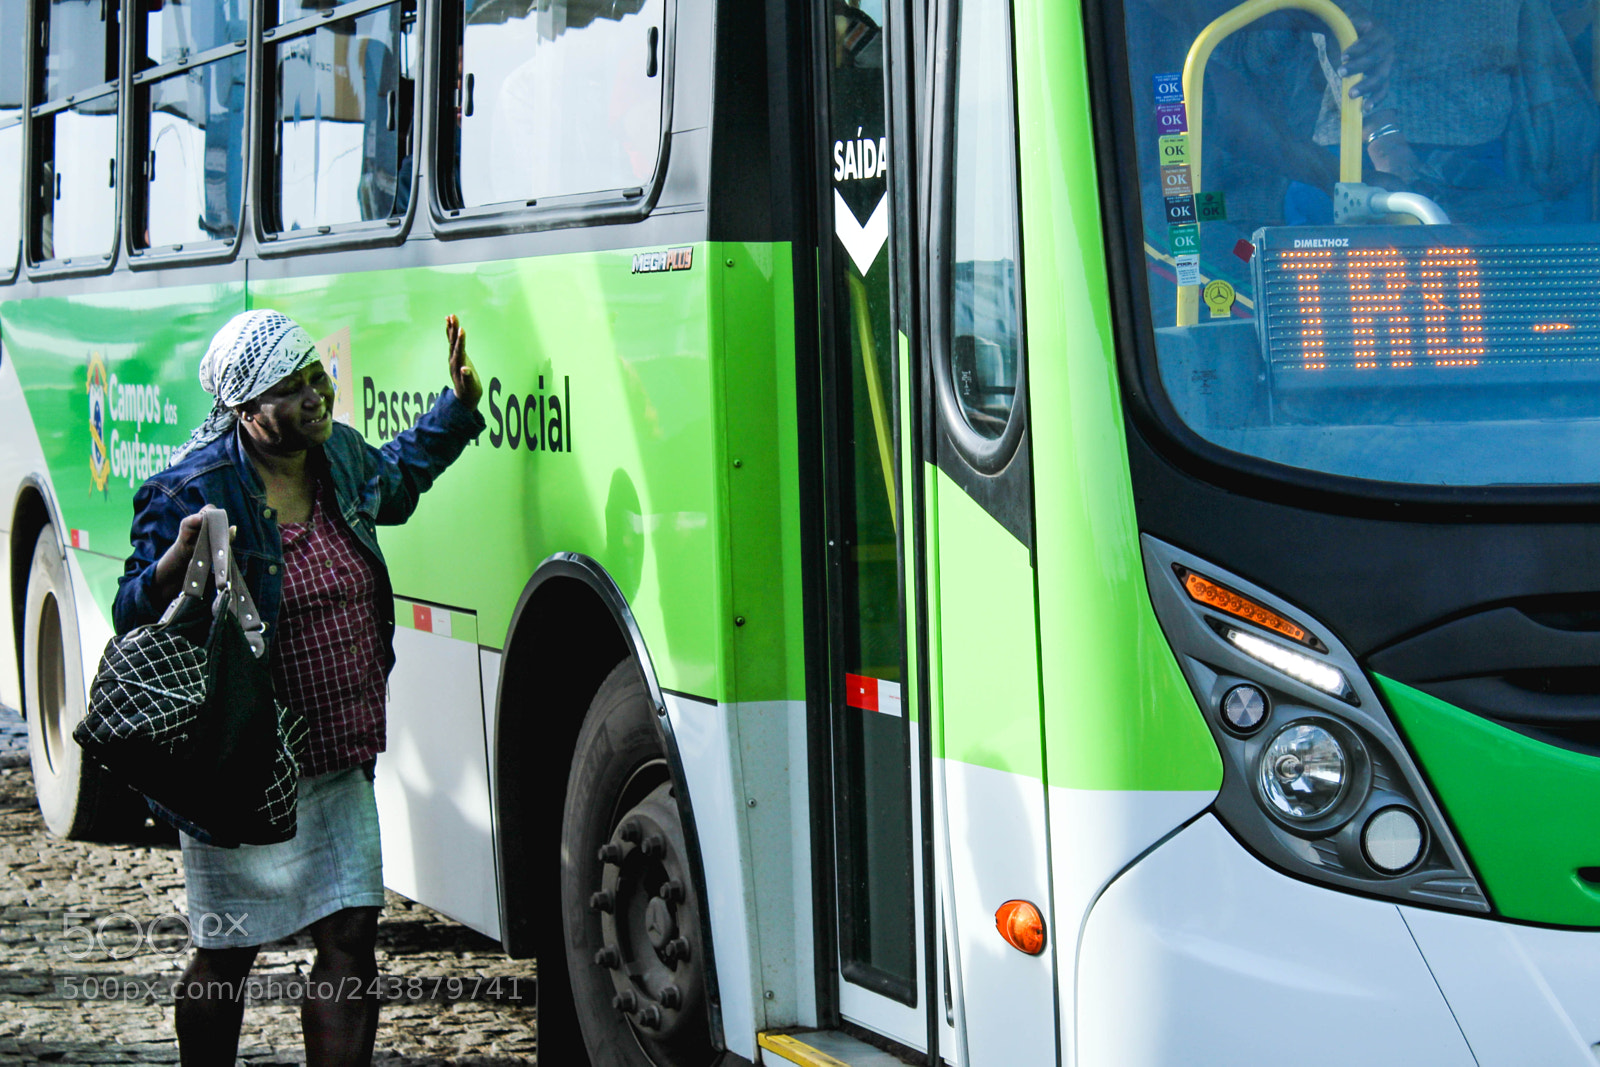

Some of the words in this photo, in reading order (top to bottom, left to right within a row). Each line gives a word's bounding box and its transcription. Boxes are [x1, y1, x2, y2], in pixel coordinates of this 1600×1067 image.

[1158, 82, 1179, 94] OK
[1161, 114, 1182, 126] OK
[833, 125, 887, 182] SAÍDA
[1164, 145, 1185, 156] OK
[1166, 174, 1188, 186] OK
[1170, 205, 1191, 218] OK
[1202, 206, 1220, 217] OK
[1174, 235, 1196, 247] OK
[1293, 237, 1349, 249] DIMELTHOZ
[108, 373, 161, 432] Campos
[163, 398, 178, 425] dos
[488, 374, 572, 453] Social
[110, 428, 178, 488] Goytacaz
